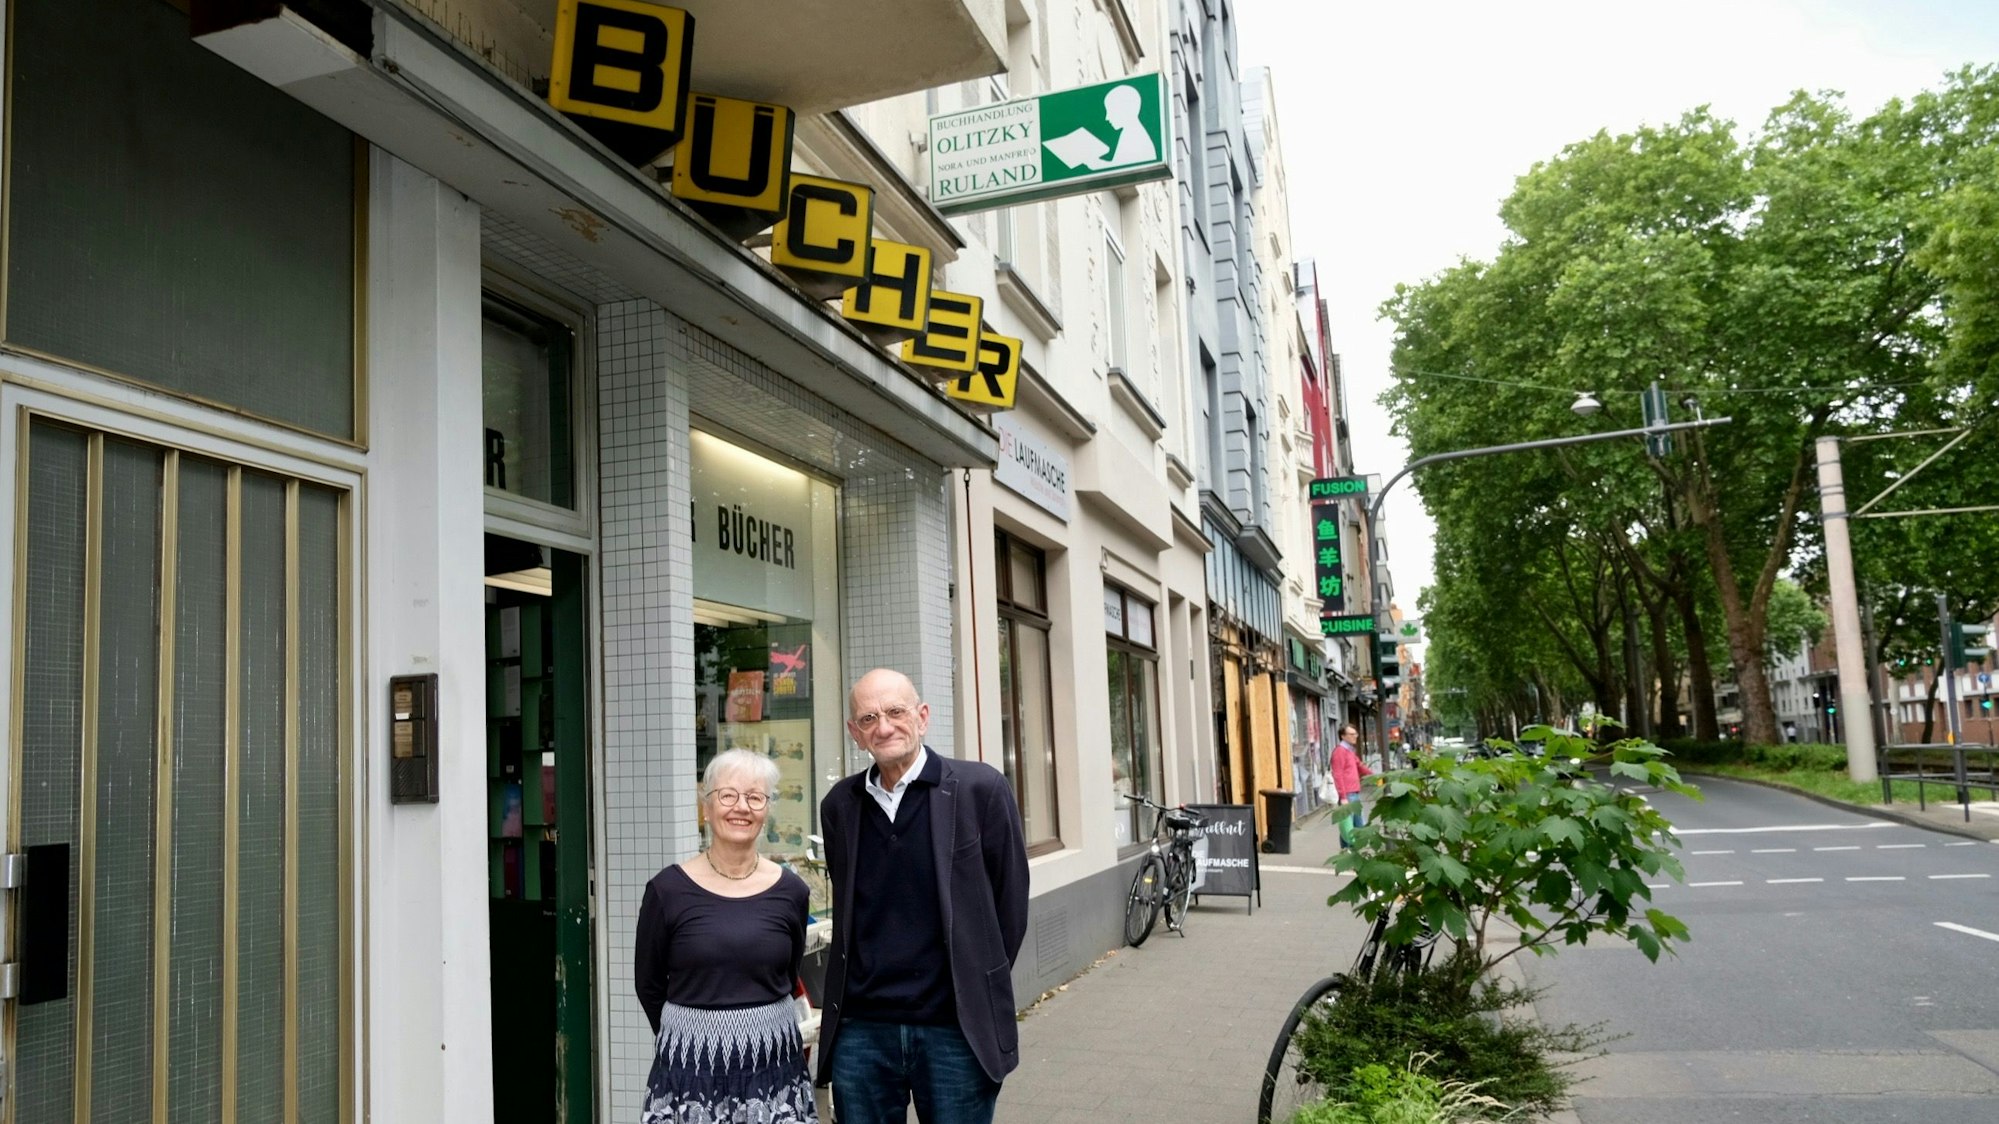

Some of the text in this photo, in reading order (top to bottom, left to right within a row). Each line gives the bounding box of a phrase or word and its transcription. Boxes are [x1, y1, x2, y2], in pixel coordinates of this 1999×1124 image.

[937, 105, 1033, 130] BUCHHANDLUNG
[937, 121, 1034, 154] OLITZKY
[938, 162, 963, 172] NORA
[966, 156, 987, 167] UND
[939, 163, 1037, 197] RULAND
[569, 3, 1010, 399] BÜCHER
[1014, 438, 1066, 494] LAUFMASCHE
[1312, 480, 1365, 495] FUSION
[718, 504, 795, 570] BÜCHER
[1316, 519, 1342, 597] 鱼羊坊
[1320, 618, 1375, 634] CUISINE
[1196, 858, 1250, 868] AUFMASCHE
